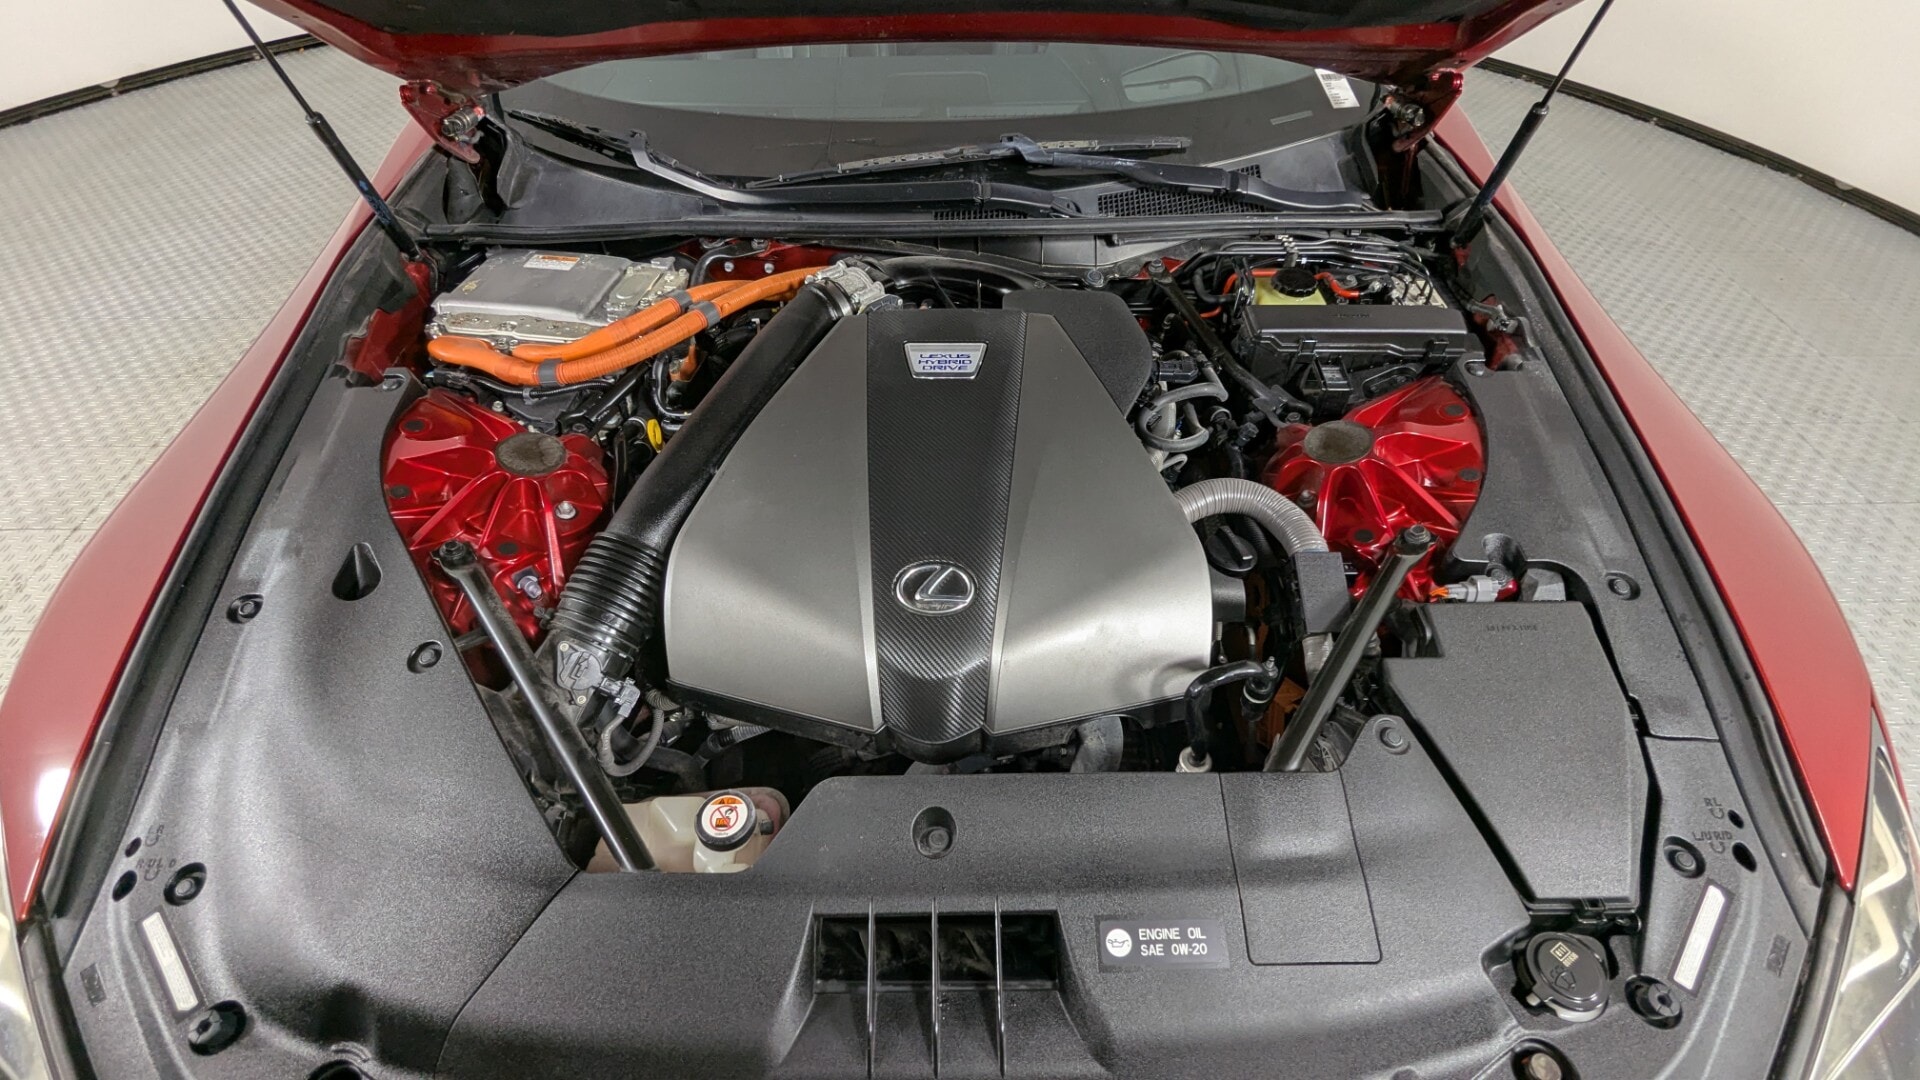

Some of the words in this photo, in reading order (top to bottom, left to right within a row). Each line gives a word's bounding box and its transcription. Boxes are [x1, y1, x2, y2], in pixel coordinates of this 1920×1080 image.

[1138, 927, 1181, 940] ENGINE
[1187, 927, 1207, 939] OIL
[1140, 943, 1165, 956] SAE
[1171, 942, 1208, 955] 0W-20
